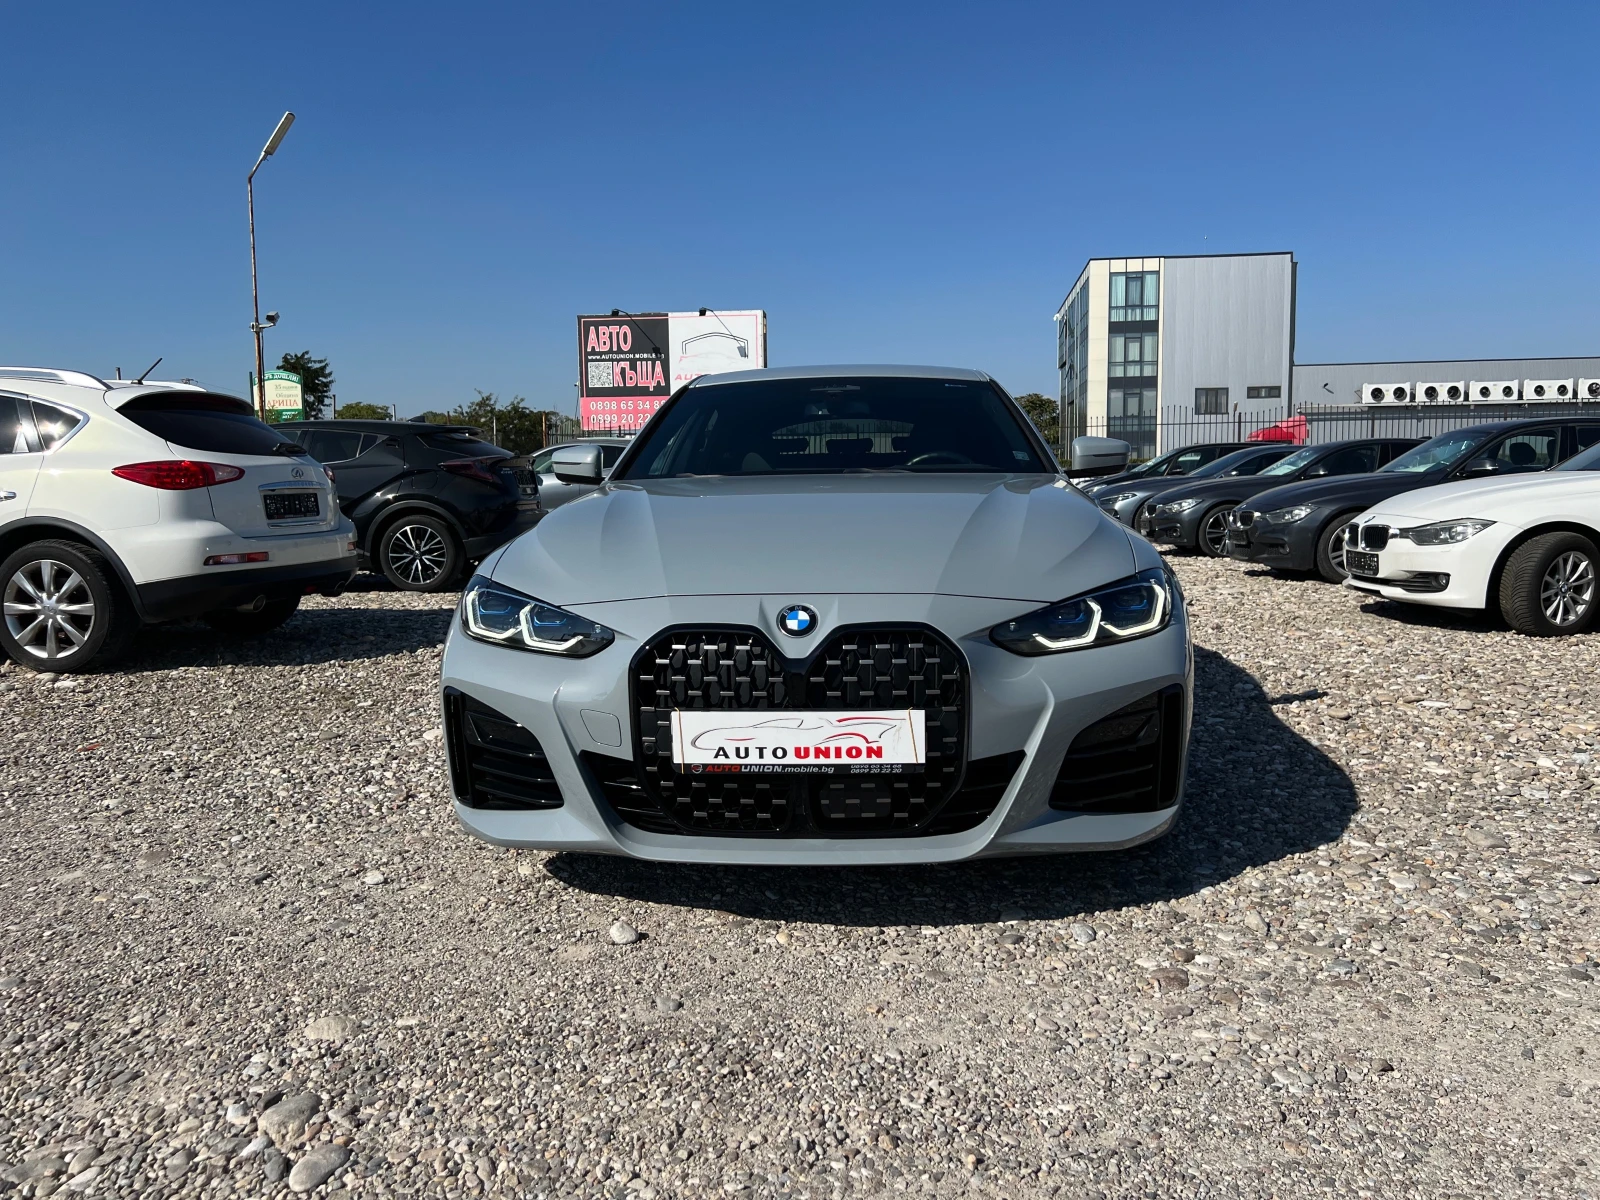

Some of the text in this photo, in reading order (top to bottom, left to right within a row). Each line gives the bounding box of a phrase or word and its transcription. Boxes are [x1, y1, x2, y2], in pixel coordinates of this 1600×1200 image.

[587, 325, 632, 351] АВТО
[613, 361, 665, 391] КЪЩА
[267, 399, 299, 407] АРИЦА
[590, 401, 617, 410] 0898
[621, 401, 634, 410] 65
[637, 400, 651, 410] 34
[590, 413, 651, 424] 0899 20 22
[713, 746, 883, 760] AUTO UNION
[705, 764, 835, 774] AUTOUNION.mobile.bg
